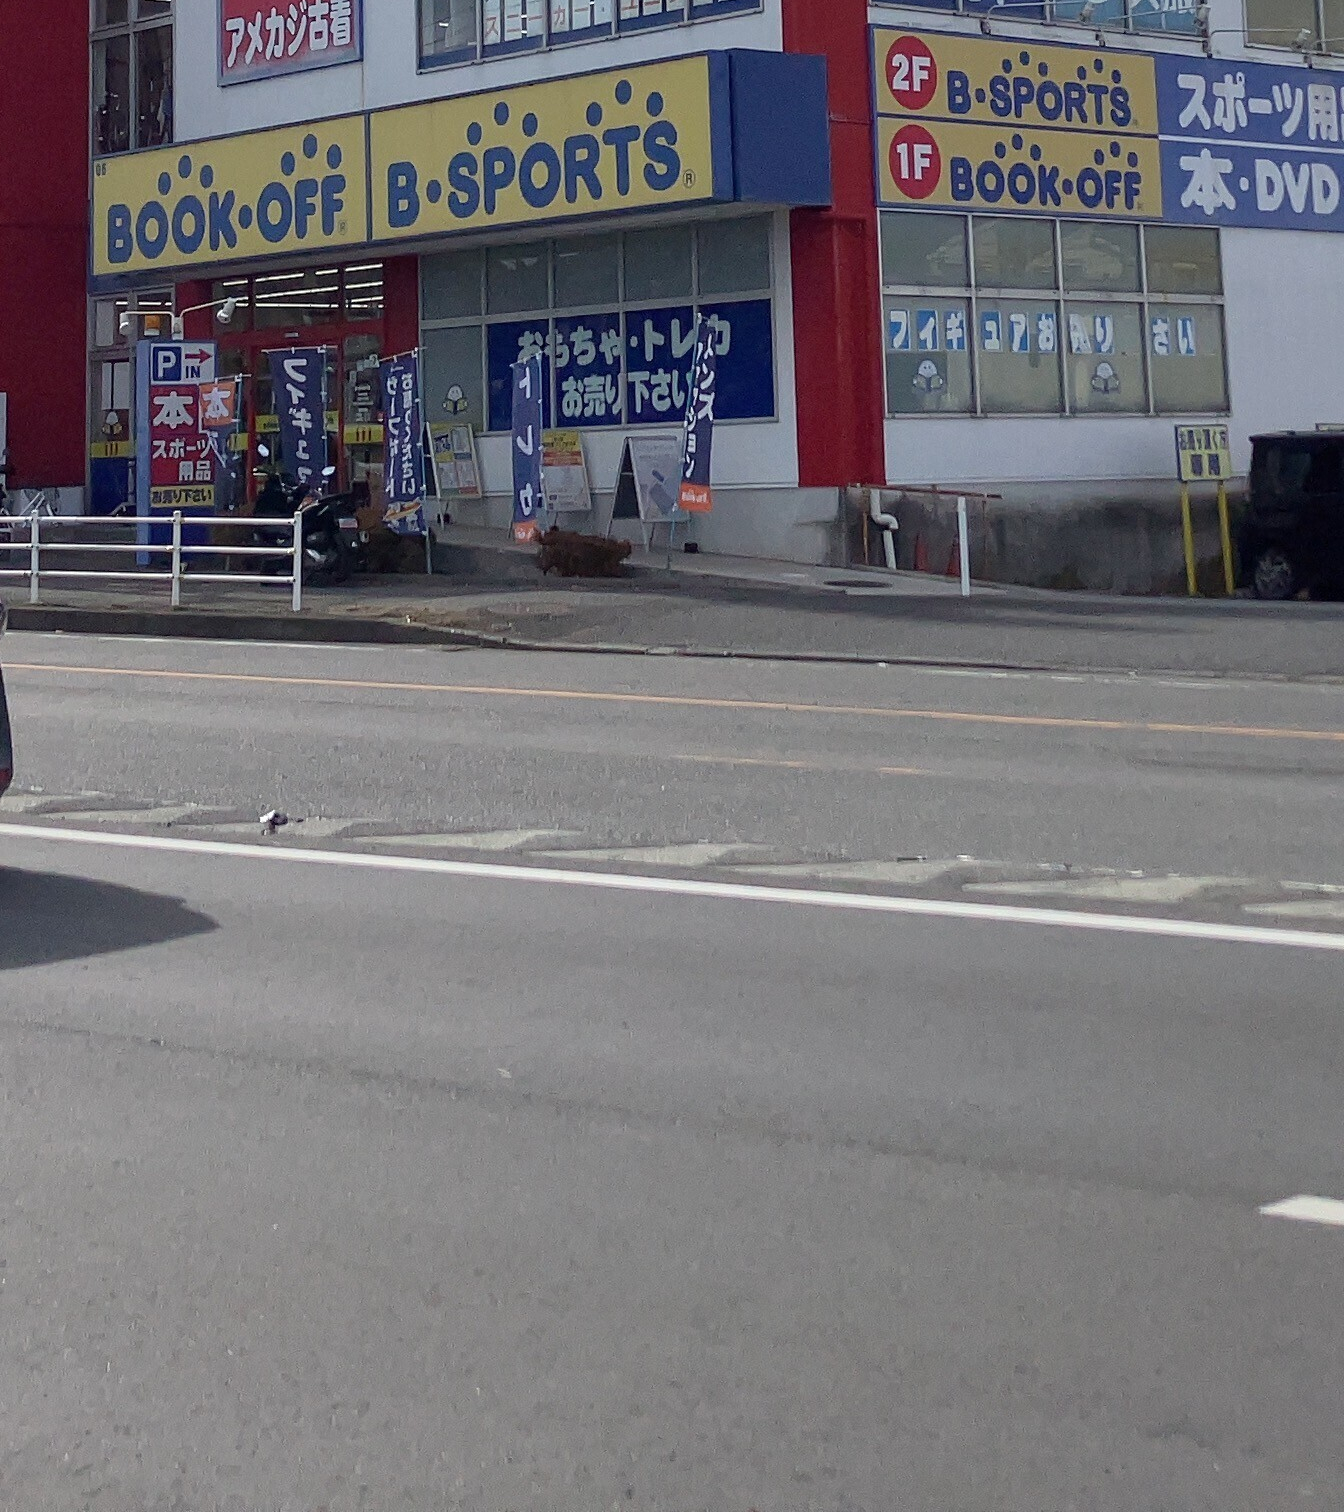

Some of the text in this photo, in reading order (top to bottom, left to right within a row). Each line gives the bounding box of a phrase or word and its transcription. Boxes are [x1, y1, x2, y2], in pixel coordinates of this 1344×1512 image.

[891, 53, 932, 93] 2F
[896, 142, 933, 181] 1F
[157, 350, 201, 379] P IN
[153, 390, 195, 430] 本
[152, 437, 213, 459] スポーツ
[178, 460, 212, 482] 用品
